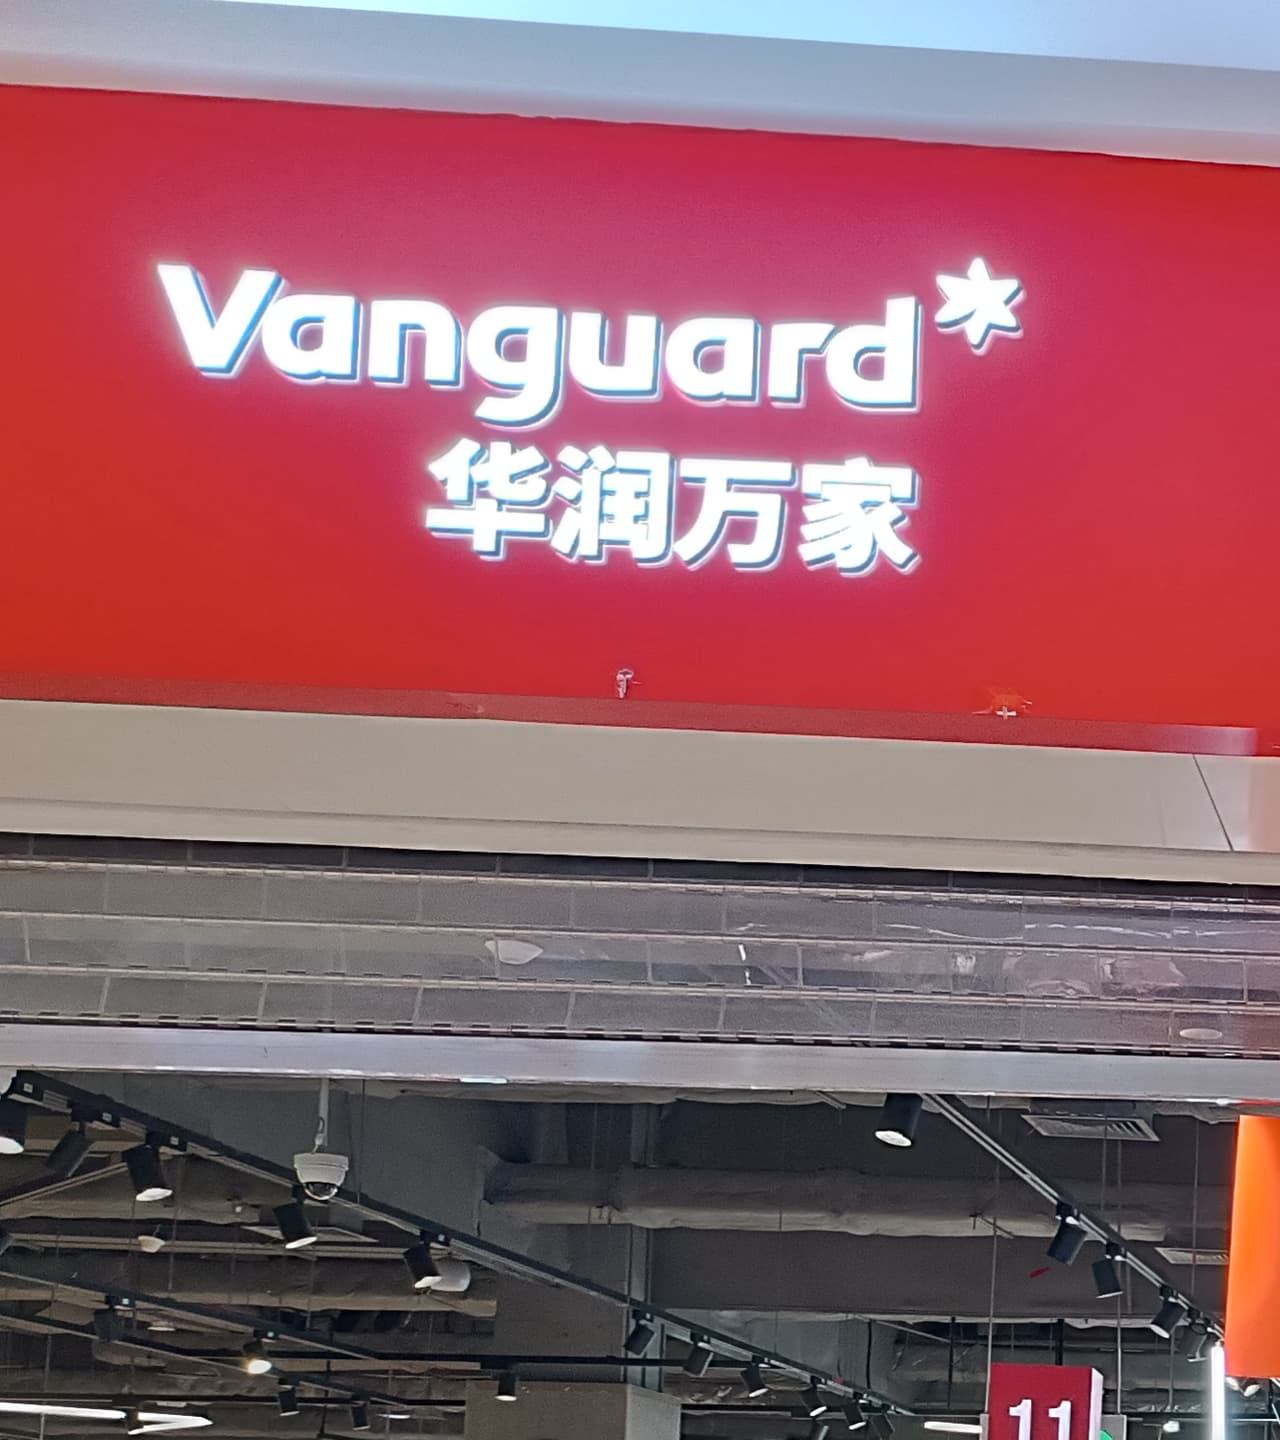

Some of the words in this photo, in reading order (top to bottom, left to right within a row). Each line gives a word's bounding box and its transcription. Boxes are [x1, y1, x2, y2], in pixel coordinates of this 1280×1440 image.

[155, 262, 922, 428] Vanguard
[425, 438, 921, 575] 华润万家
